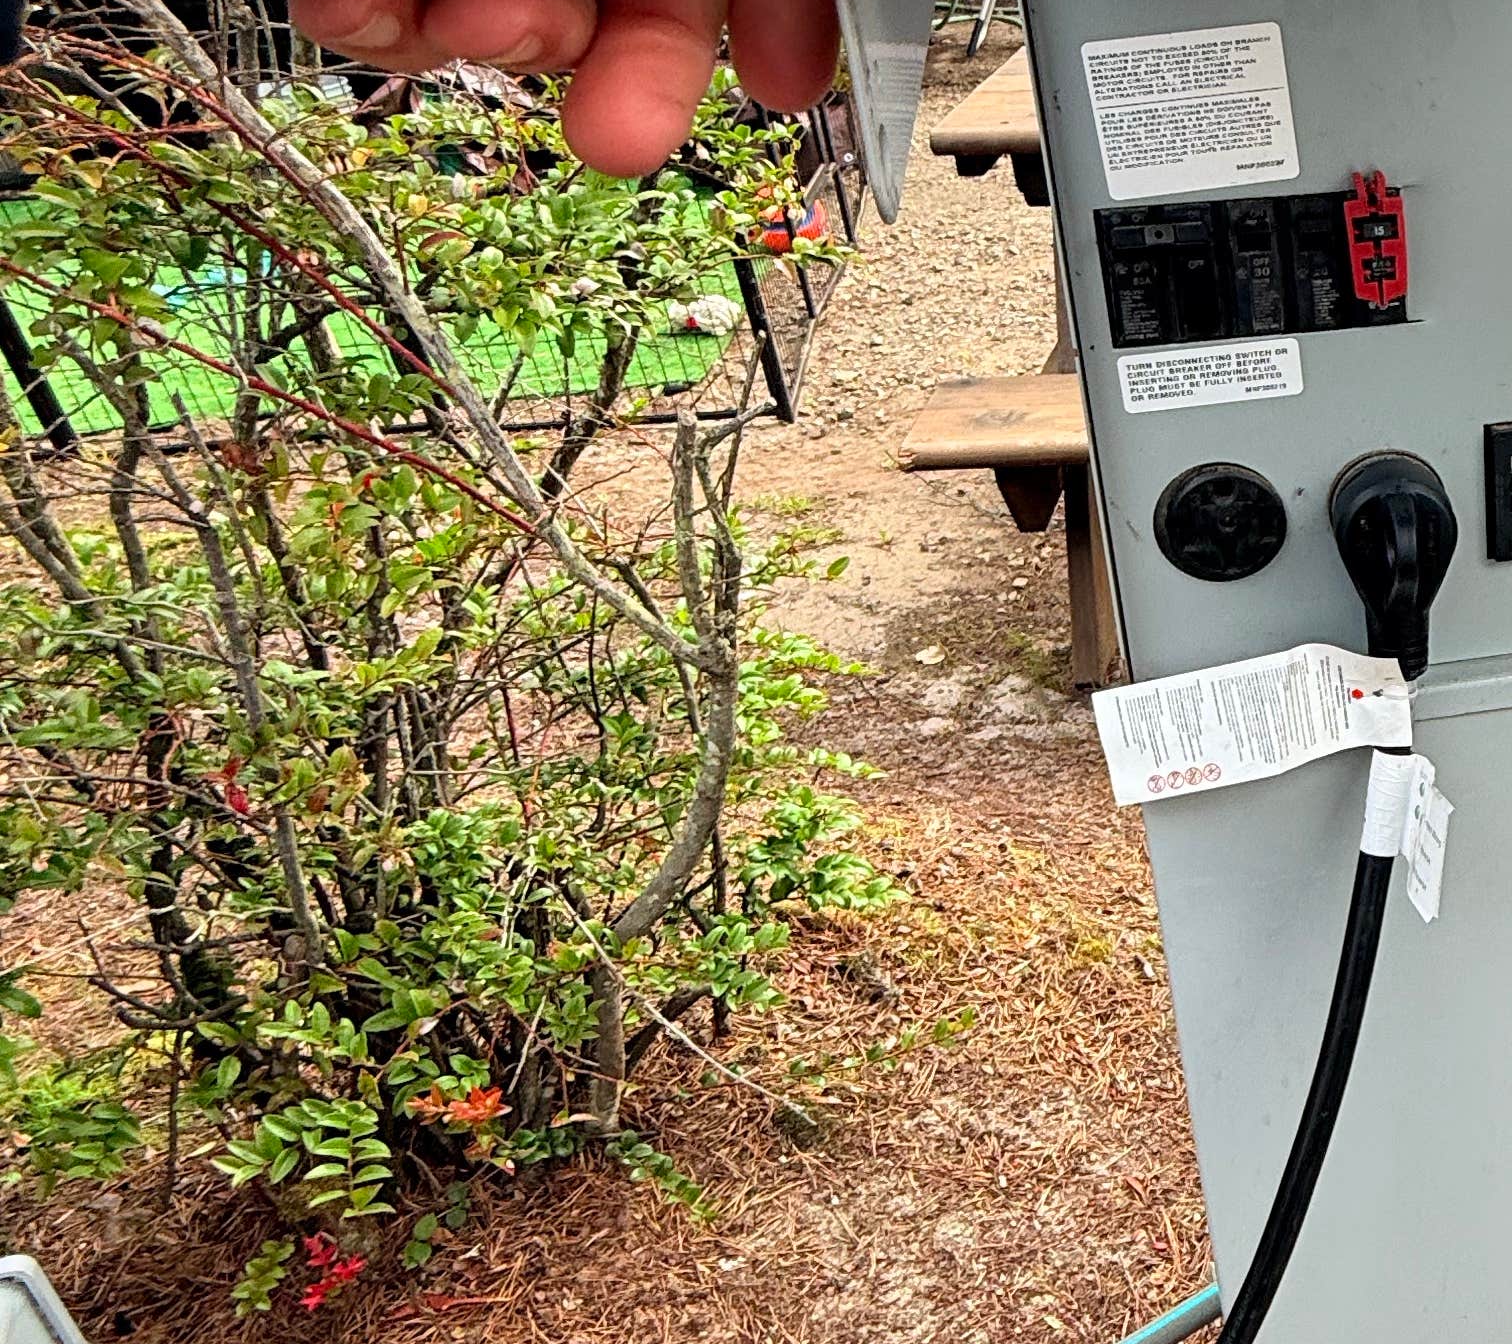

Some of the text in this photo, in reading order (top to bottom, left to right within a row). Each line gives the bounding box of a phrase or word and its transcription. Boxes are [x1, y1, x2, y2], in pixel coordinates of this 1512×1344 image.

[1131, 46, 1187, 56] CONTINUOUS
[1253, 266, 1271, 277] 30
[1126, 362, 1152, 371] TURN
[1155, 354, 1231, 368] DISCONNECTING
[1235, 349, 1272, 359] SWITCH
[1127, 369, 1164, 379] CIRCUIT
[1169, 364, 1212, 375] BREAKER
[1236, 357, 1271, 367] BEFORE
[1128, 376, 1180, 387] INSERTING
[1182, 373, 1196, 381] OR
[1200, 368, 1249, 379] REMOVING
[1130, 386, 1155, 394] PLUG
[1159, 383, 1185, 391] MUST
[1204, 377, 1233, 386] FULLY
[1237, 372, 1282, 382] INSERTED
[1131, 394, 1145, 402] OR
